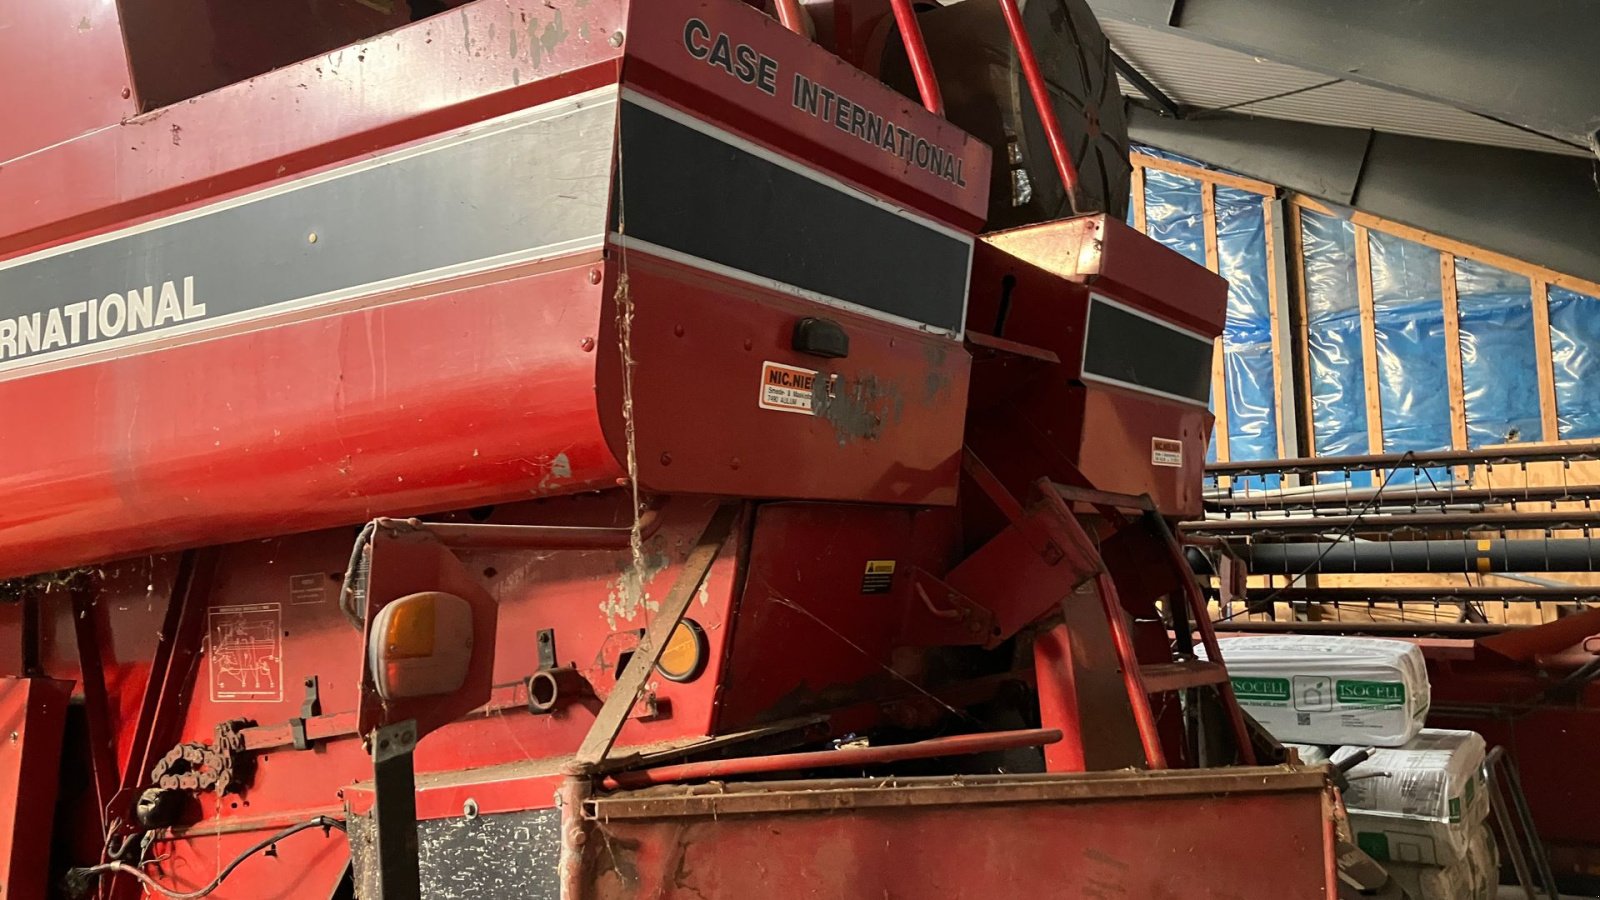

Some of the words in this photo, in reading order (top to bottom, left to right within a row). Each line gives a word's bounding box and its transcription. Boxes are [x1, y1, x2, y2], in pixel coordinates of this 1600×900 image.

[684, 18, 778, 96] CASE
[792, 73, 966, 188] INTERNATIONAL
[1340, 684, 1402, 699] ISOCELL
